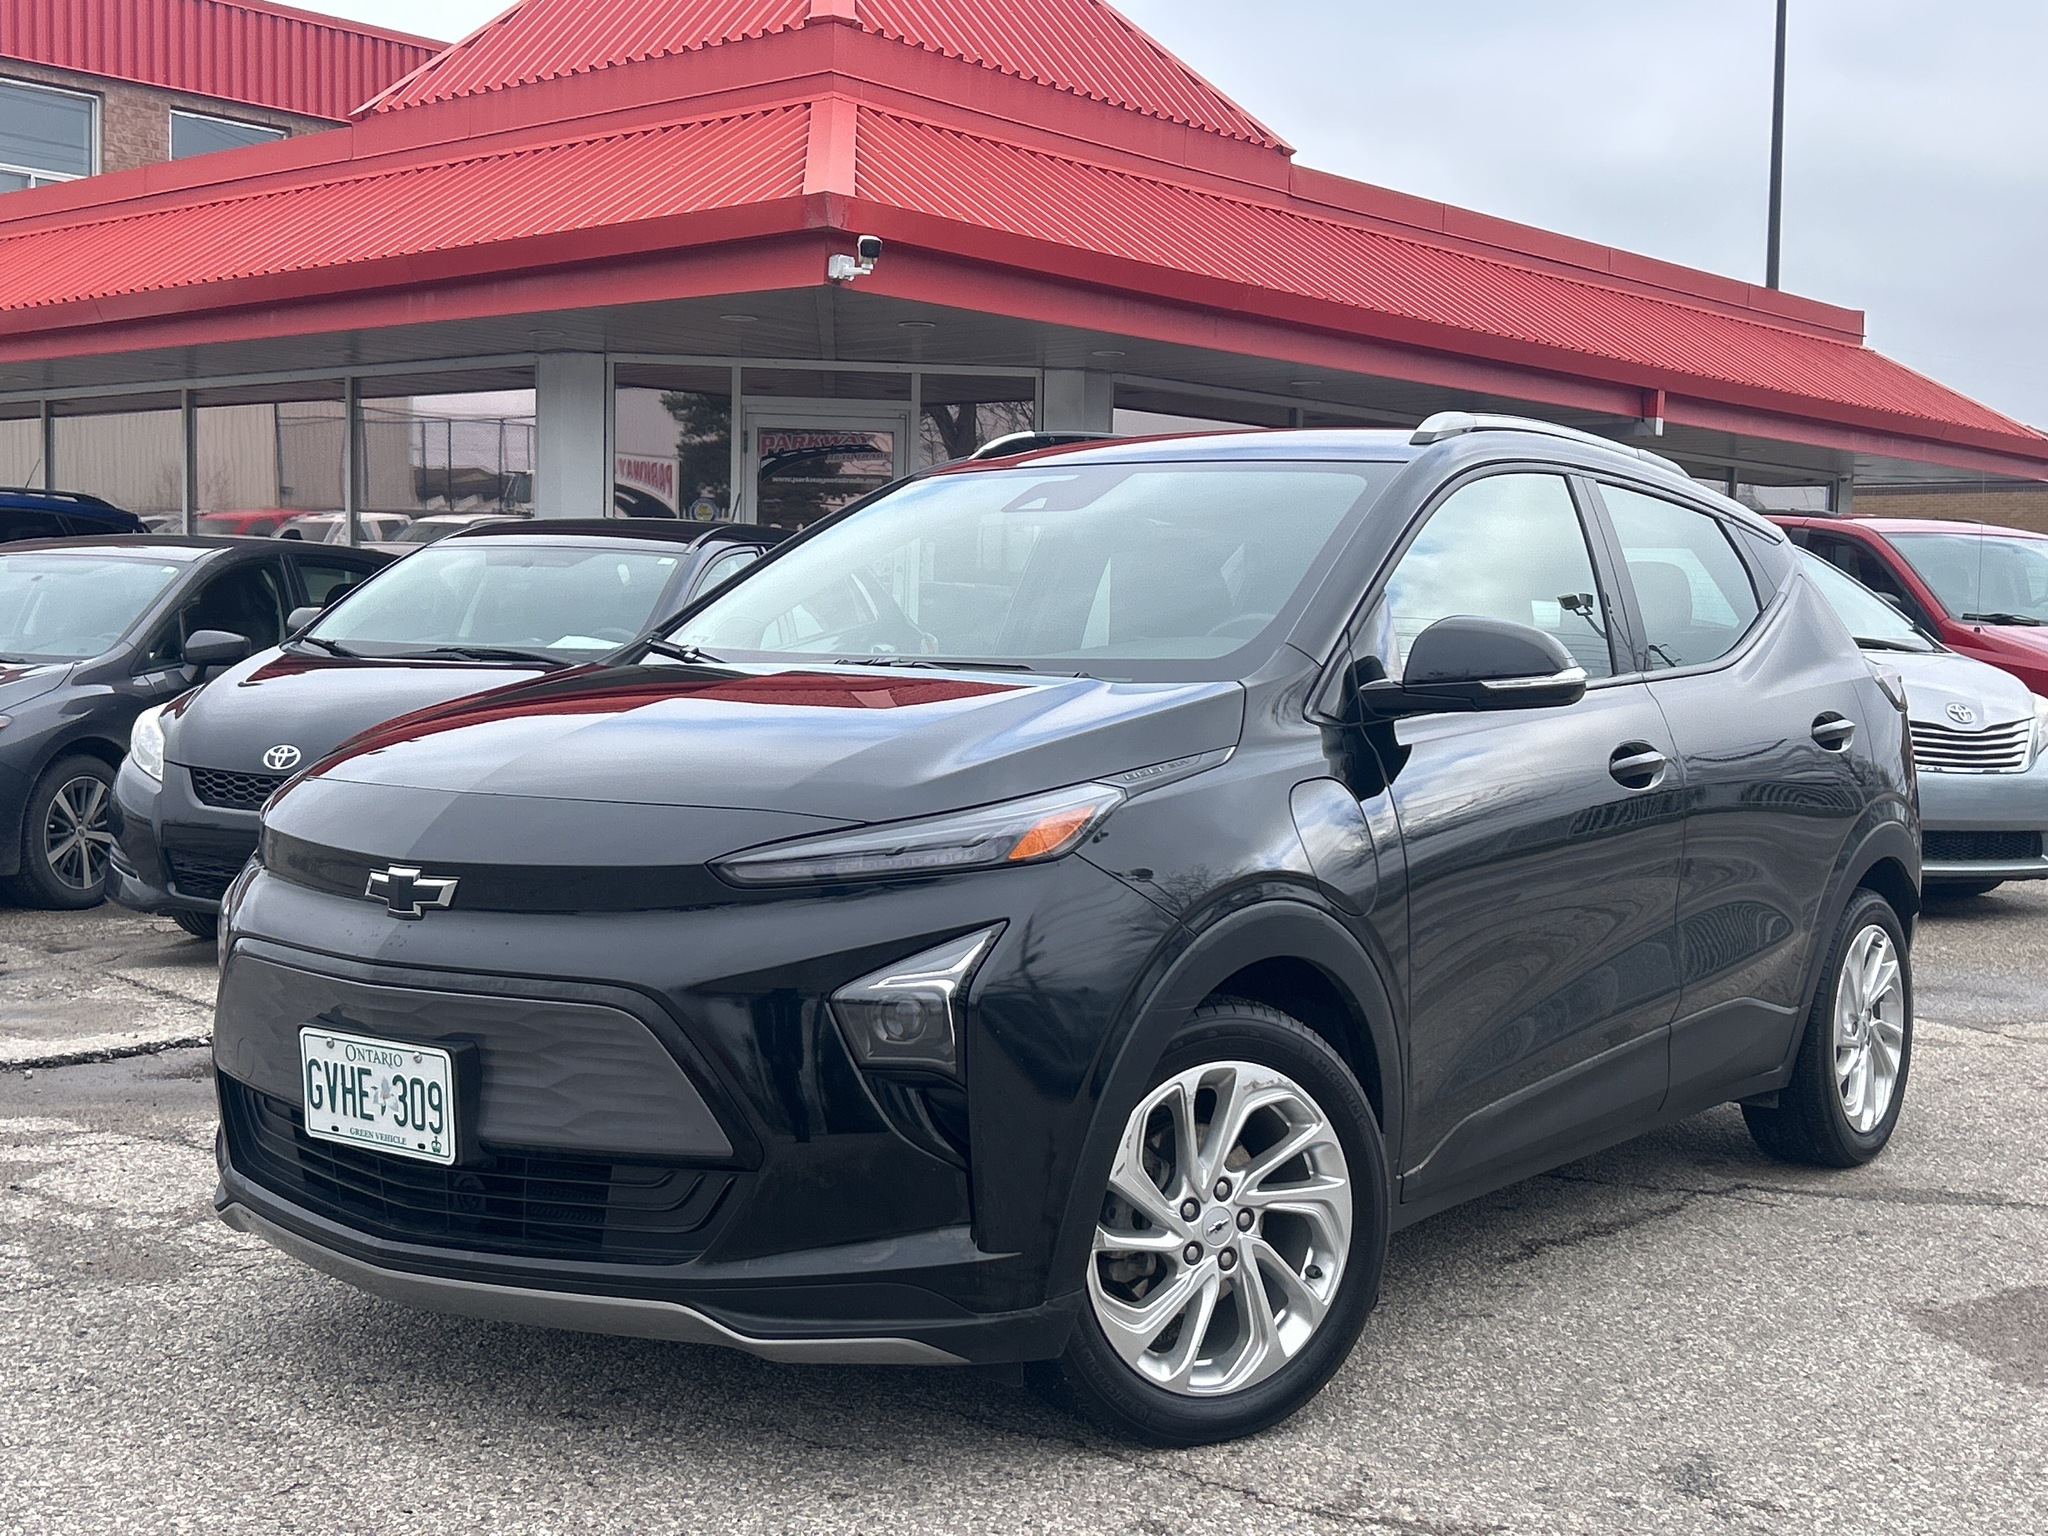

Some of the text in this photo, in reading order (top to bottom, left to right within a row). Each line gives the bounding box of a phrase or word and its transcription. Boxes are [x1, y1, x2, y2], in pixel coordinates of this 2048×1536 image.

[760, 433, 874, 457] PARKWAY
[345, 1044, 403, 1069] ONTARIO
[307, 1058, 444, 1135] GVHE 309
[349, 1127, 407, 1146] GREEN VEHICLE
